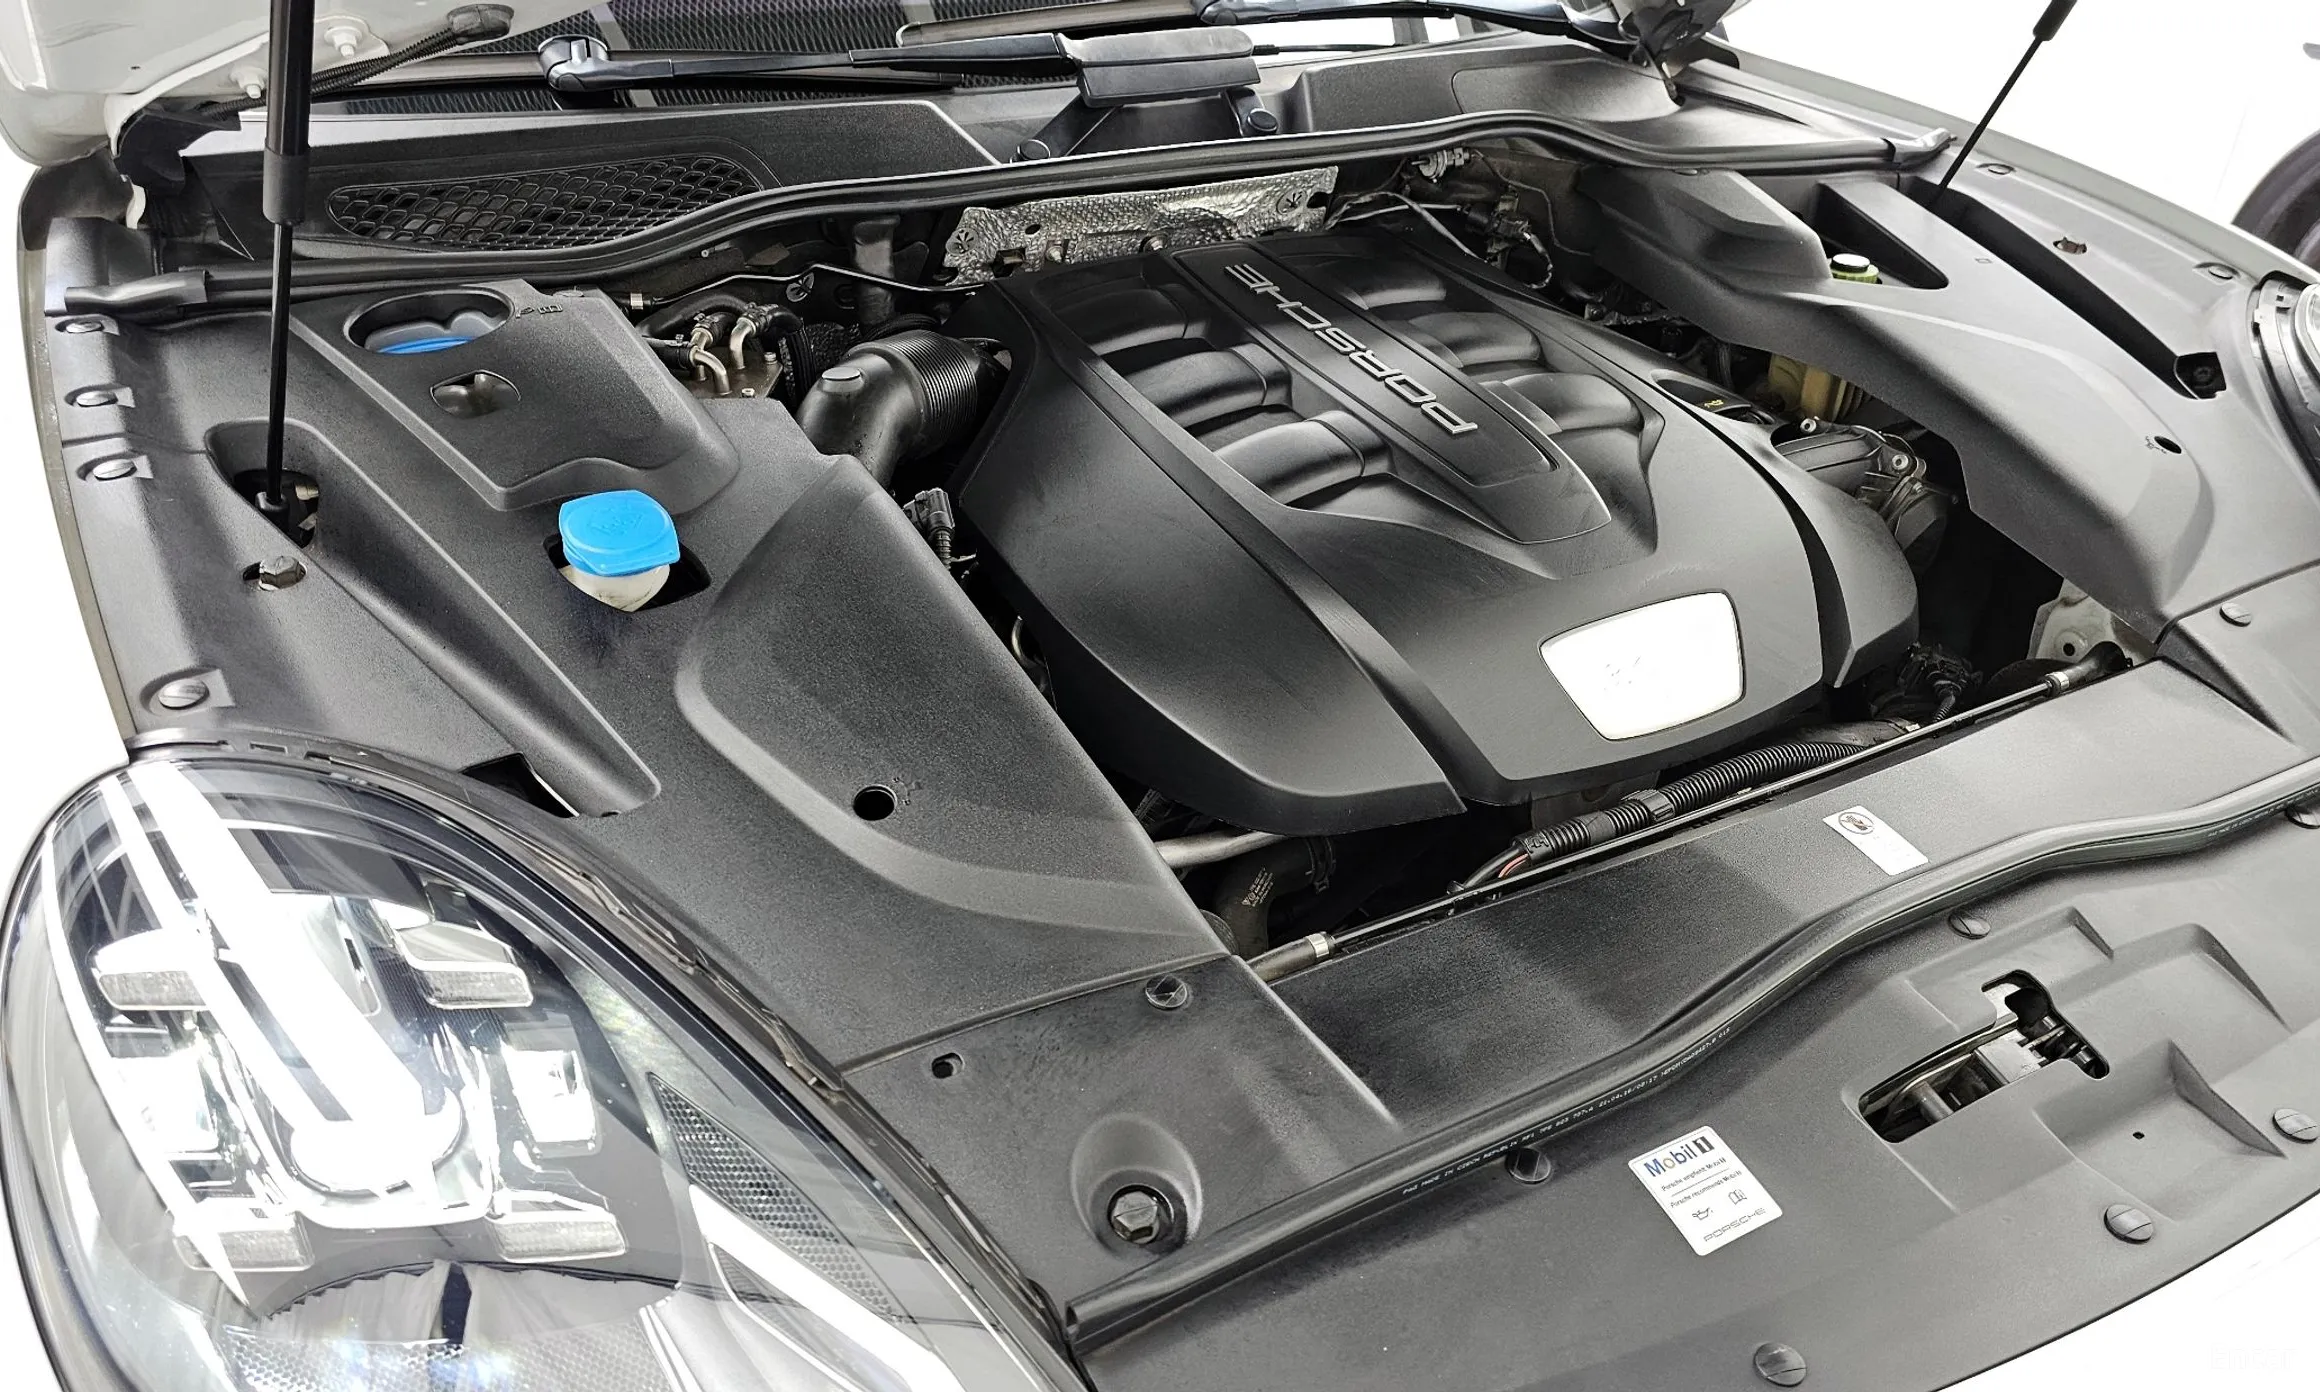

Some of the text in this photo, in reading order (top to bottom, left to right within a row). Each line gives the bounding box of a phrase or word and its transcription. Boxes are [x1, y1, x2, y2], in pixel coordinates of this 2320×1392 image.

[1223, 263, 1478, 434] PORSCHE
[1643, 1143, 1698, 1177] Mobil
[1661, 1178, 1683, 1191] Porsche
[1670, 1194, 1692, 1208] Porsche
[1703, 1207, 1767, 1242] PORSCHE
